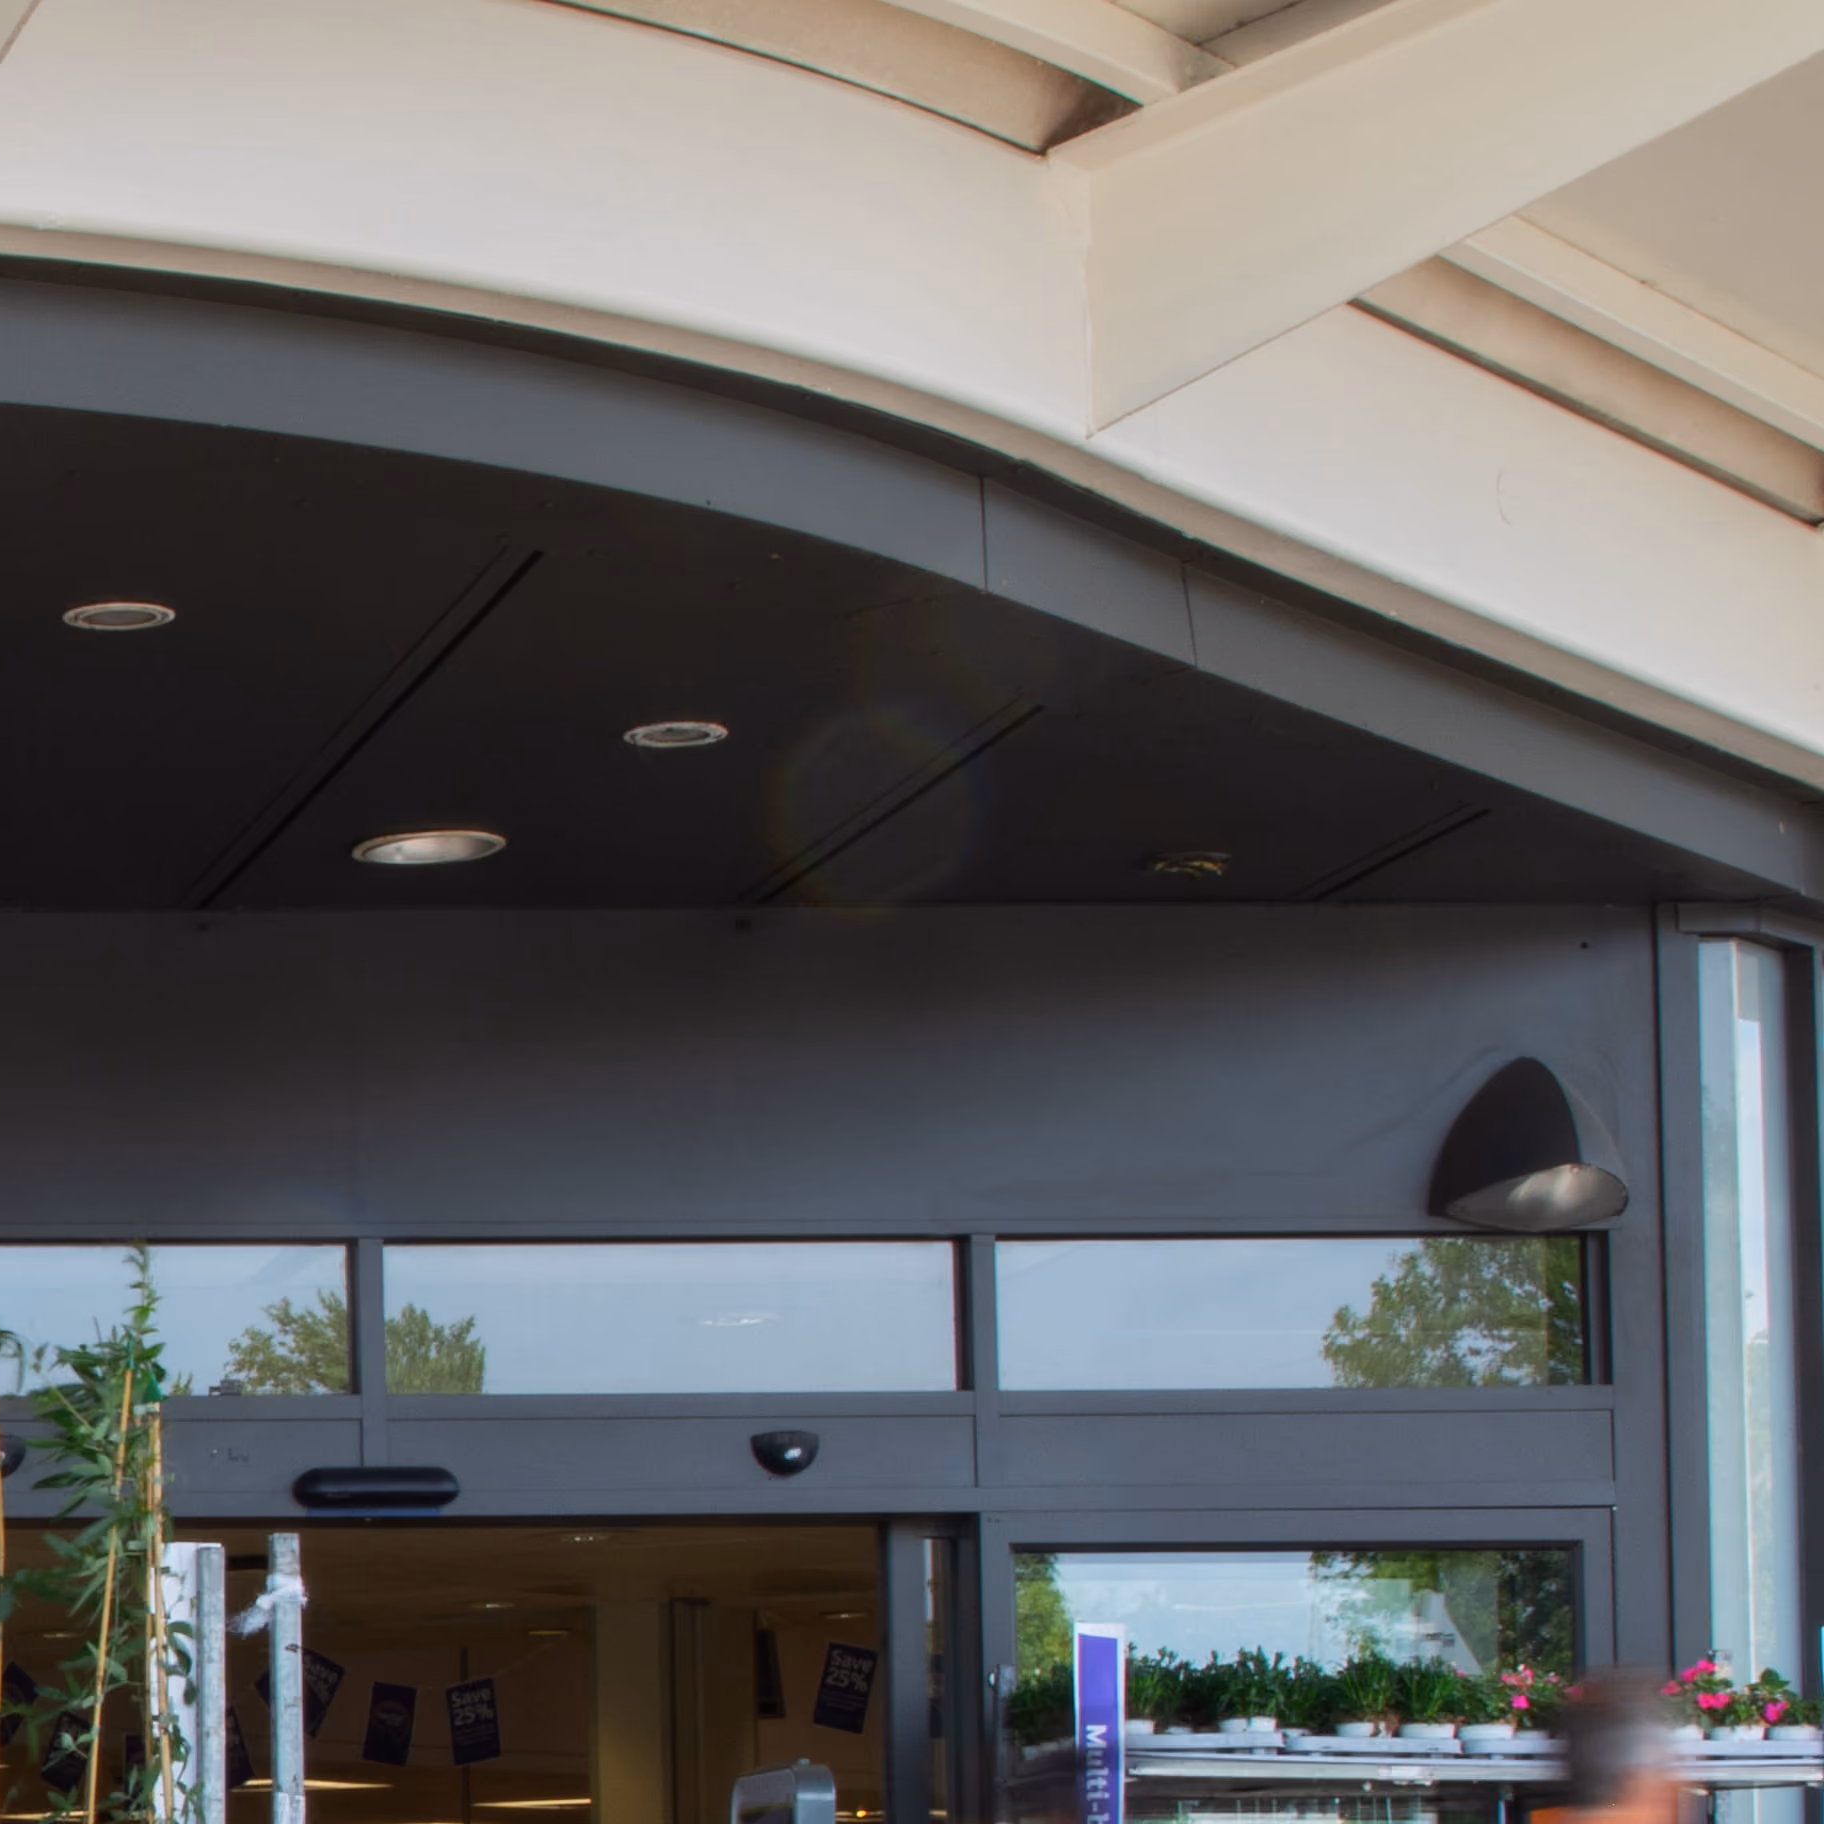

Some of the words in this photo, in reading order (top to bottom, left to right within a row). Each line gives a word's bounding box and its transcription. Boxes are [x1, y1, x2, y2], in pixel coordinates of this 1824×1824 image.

[831, 1649, 872, 1674] Save
[825, 1666, 868, 1692] 25%
[450, 1687, 493, 1708] Save
[452, 1703, 494, 1726] 25%
